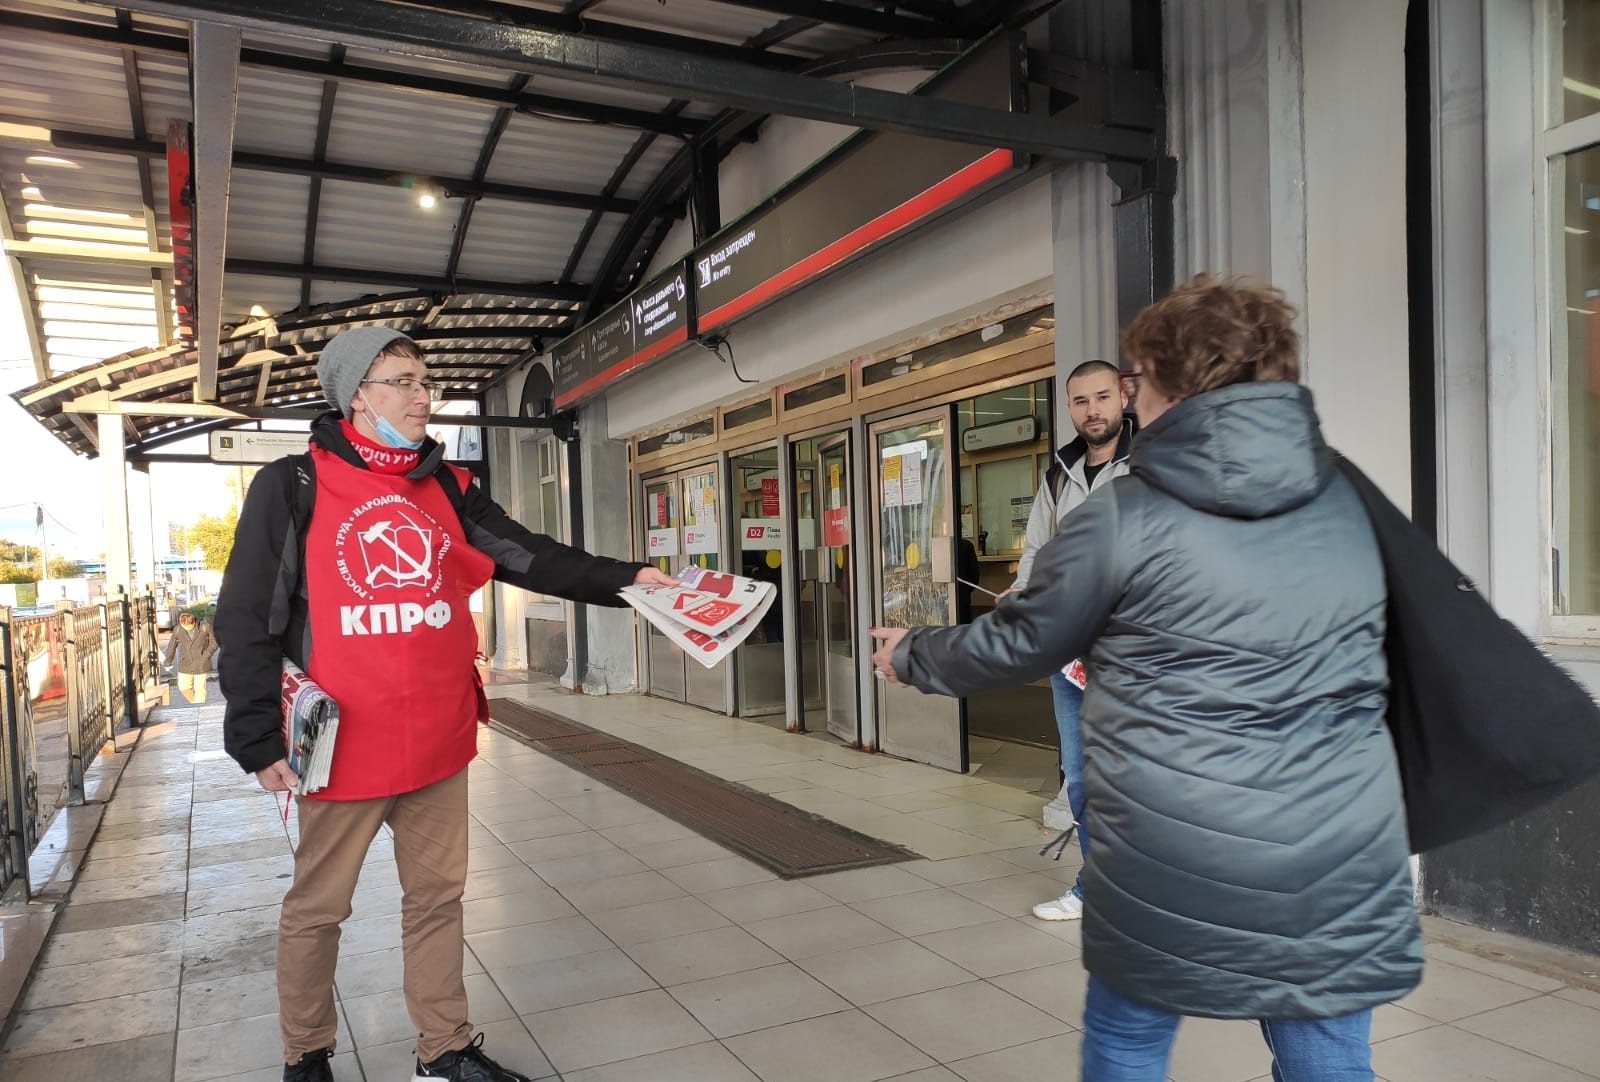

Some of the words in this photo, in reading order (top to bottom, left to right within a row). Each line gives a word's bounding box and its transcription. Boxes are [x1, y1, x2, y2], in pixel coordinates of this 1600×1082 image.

[711, 250, 726, 266] Вход
[726, 229, 756, 257] запрещен
[224, 438, 230, 447] 1
[336, 522, 353, 547] ТРУД
[750, 528, 761, 537] D2
[336, 559, 368, 598] РОССИЯ
[340, 600, 451, 636] КПРФ
